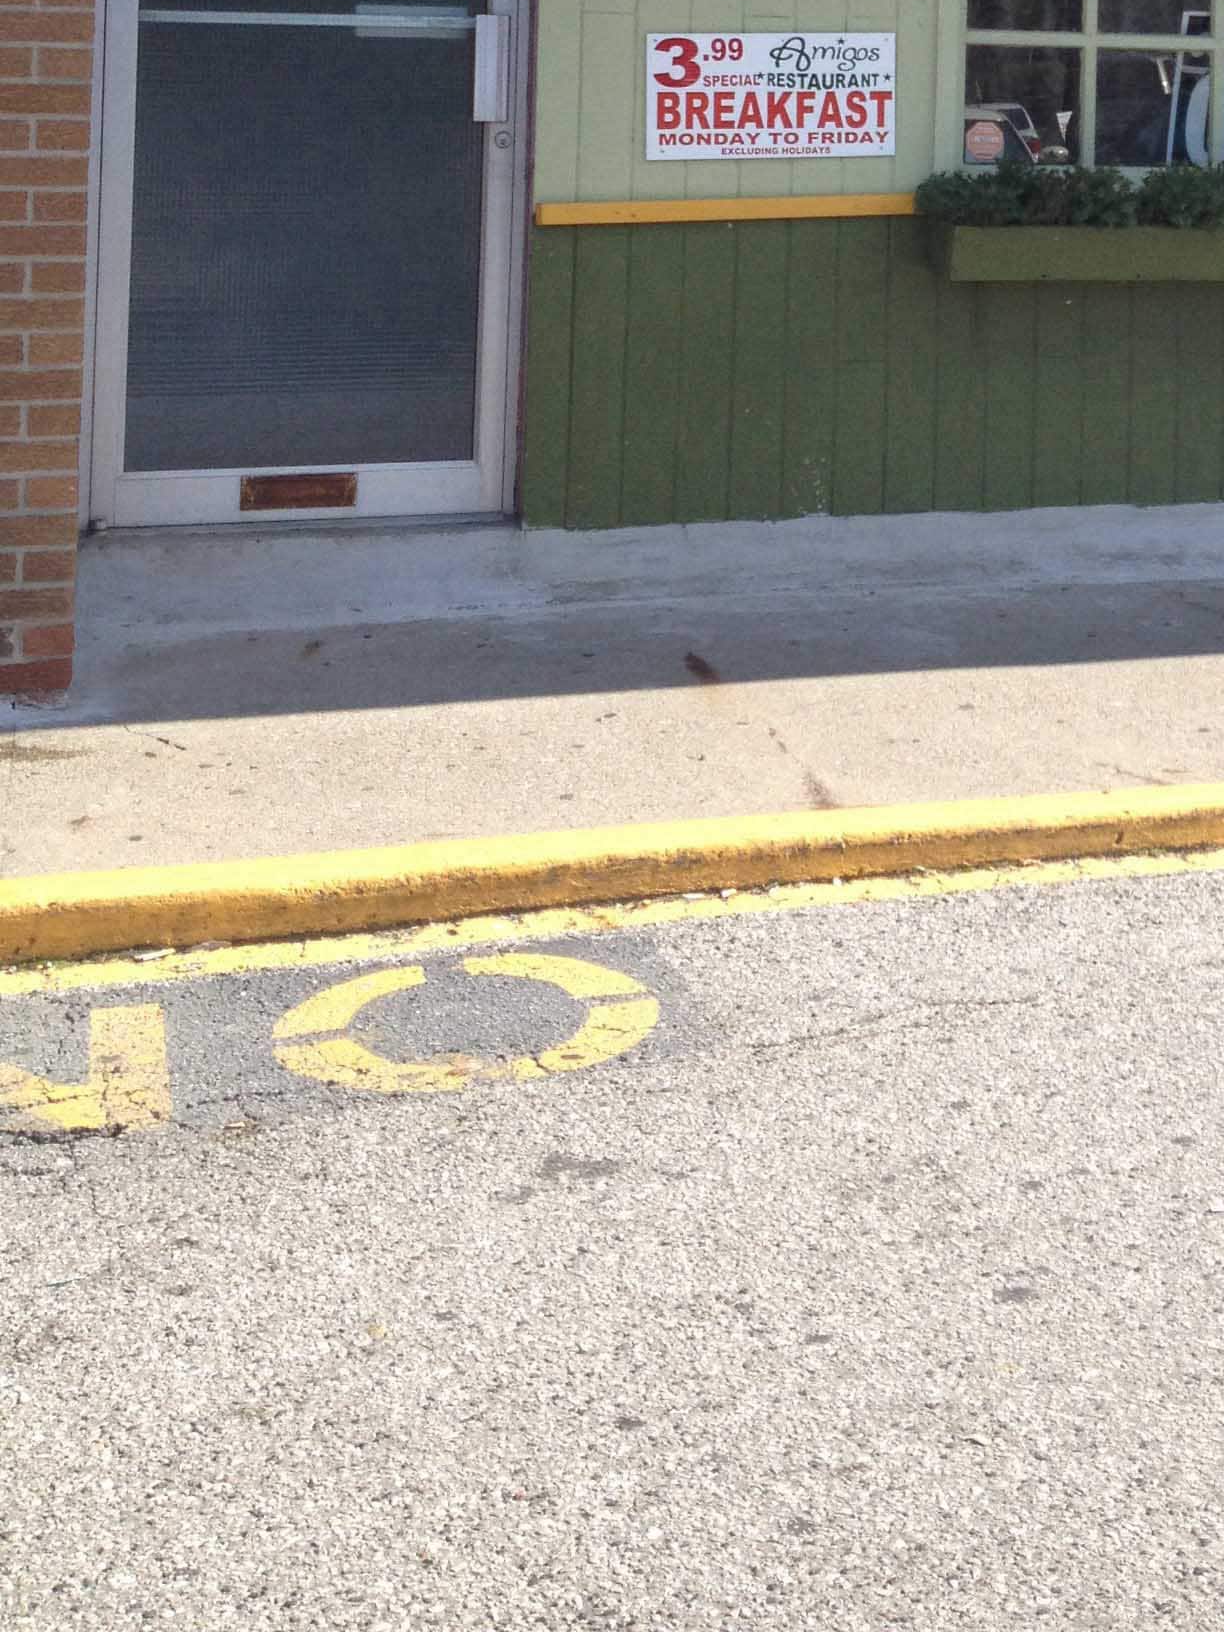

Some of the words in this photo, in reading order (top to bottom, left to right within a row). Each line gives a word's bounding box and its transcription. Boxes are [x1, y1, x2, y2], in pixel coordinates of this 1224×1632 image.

[653, 37, 744, 88] 3.99
[769, 36, 881, 72] Amigos
[703, 74, 761, 88] SPECIAL
[767, 72, 880, 91] RESTAURANT
[656, 90, 894, 131] BREAKFAST
[658, 131, 762, 146] MONDAY
[769, 131, 800, 145] TO
[807, 130, 890, 145] FRIDAY
[721, 146, 779, 156] EXCLUDING
[781, 146, 832, 156] HOLIDAYS
